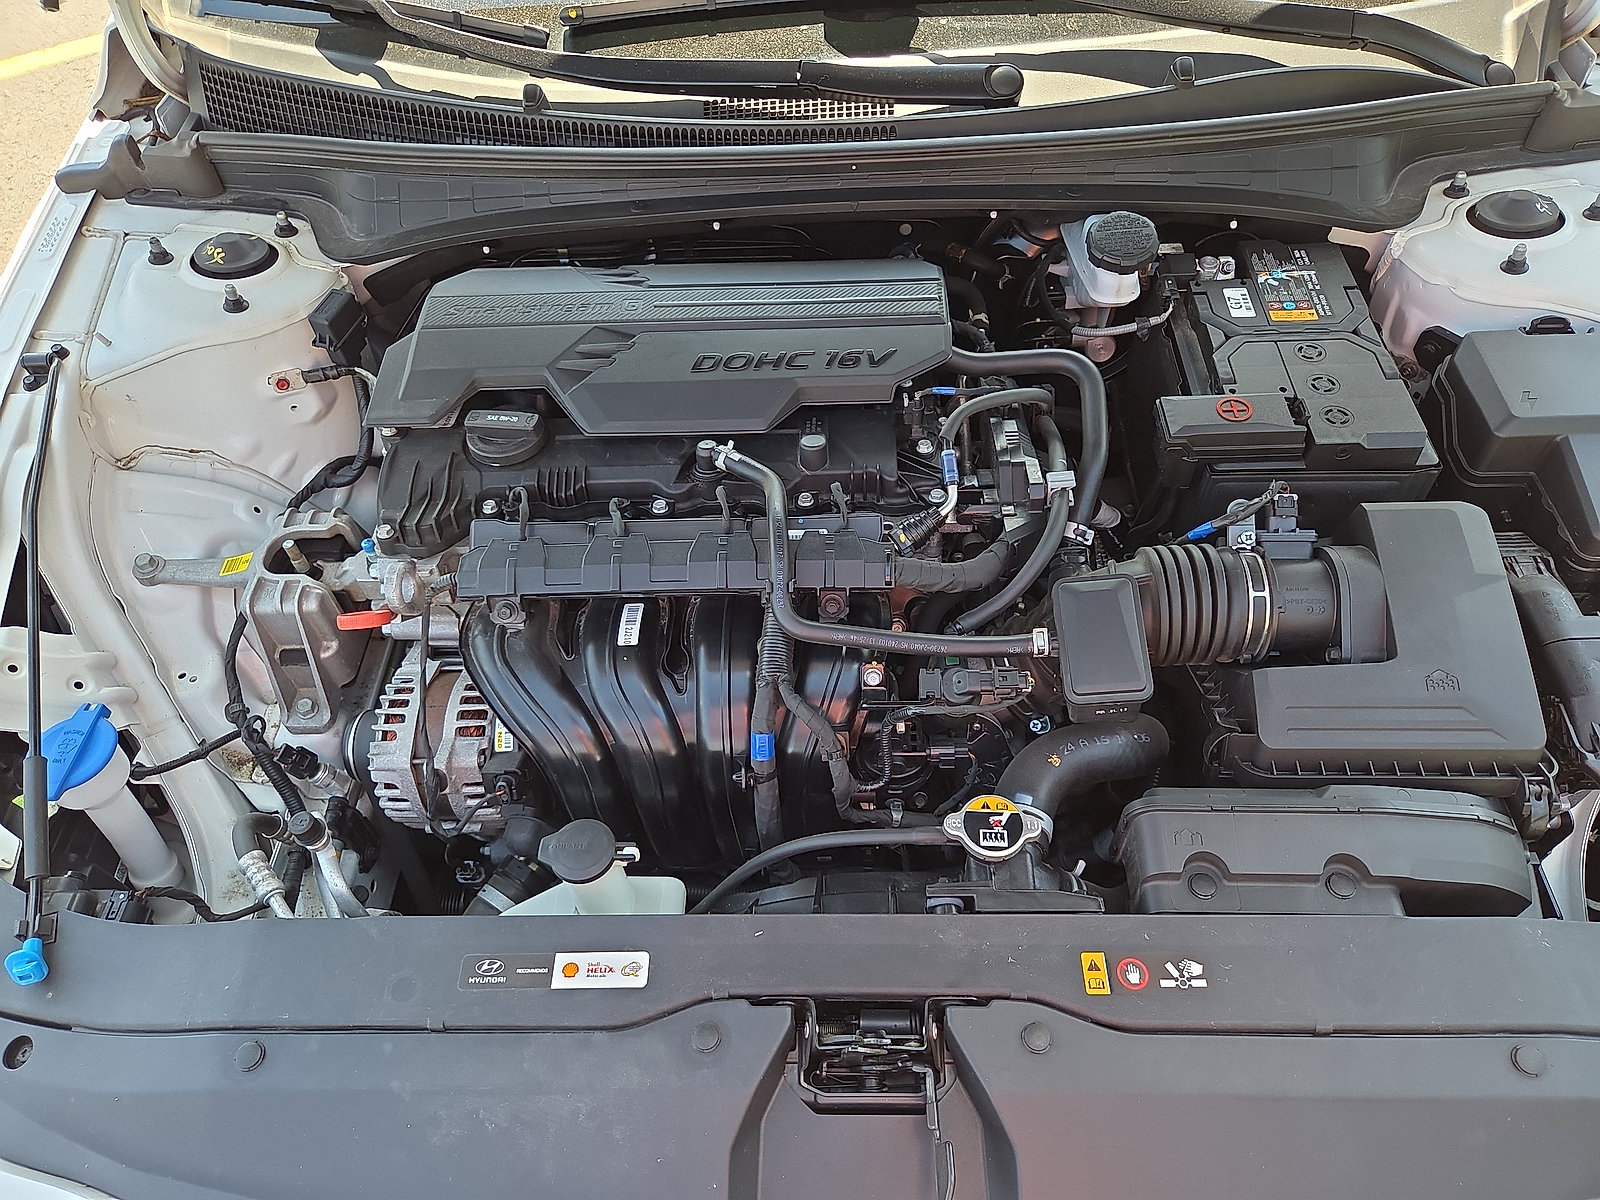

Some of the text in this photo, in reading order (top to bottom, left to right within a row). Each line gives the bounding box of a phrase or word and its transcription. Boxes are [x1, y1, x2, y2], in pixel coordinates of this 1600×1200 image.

[443, 298, 644, 318] Smartstream G
[690, 347, 898, 373] DOHC 16V
[1060, 742, 1076, 756] 24
[946, 819, 962, 828] HCC
